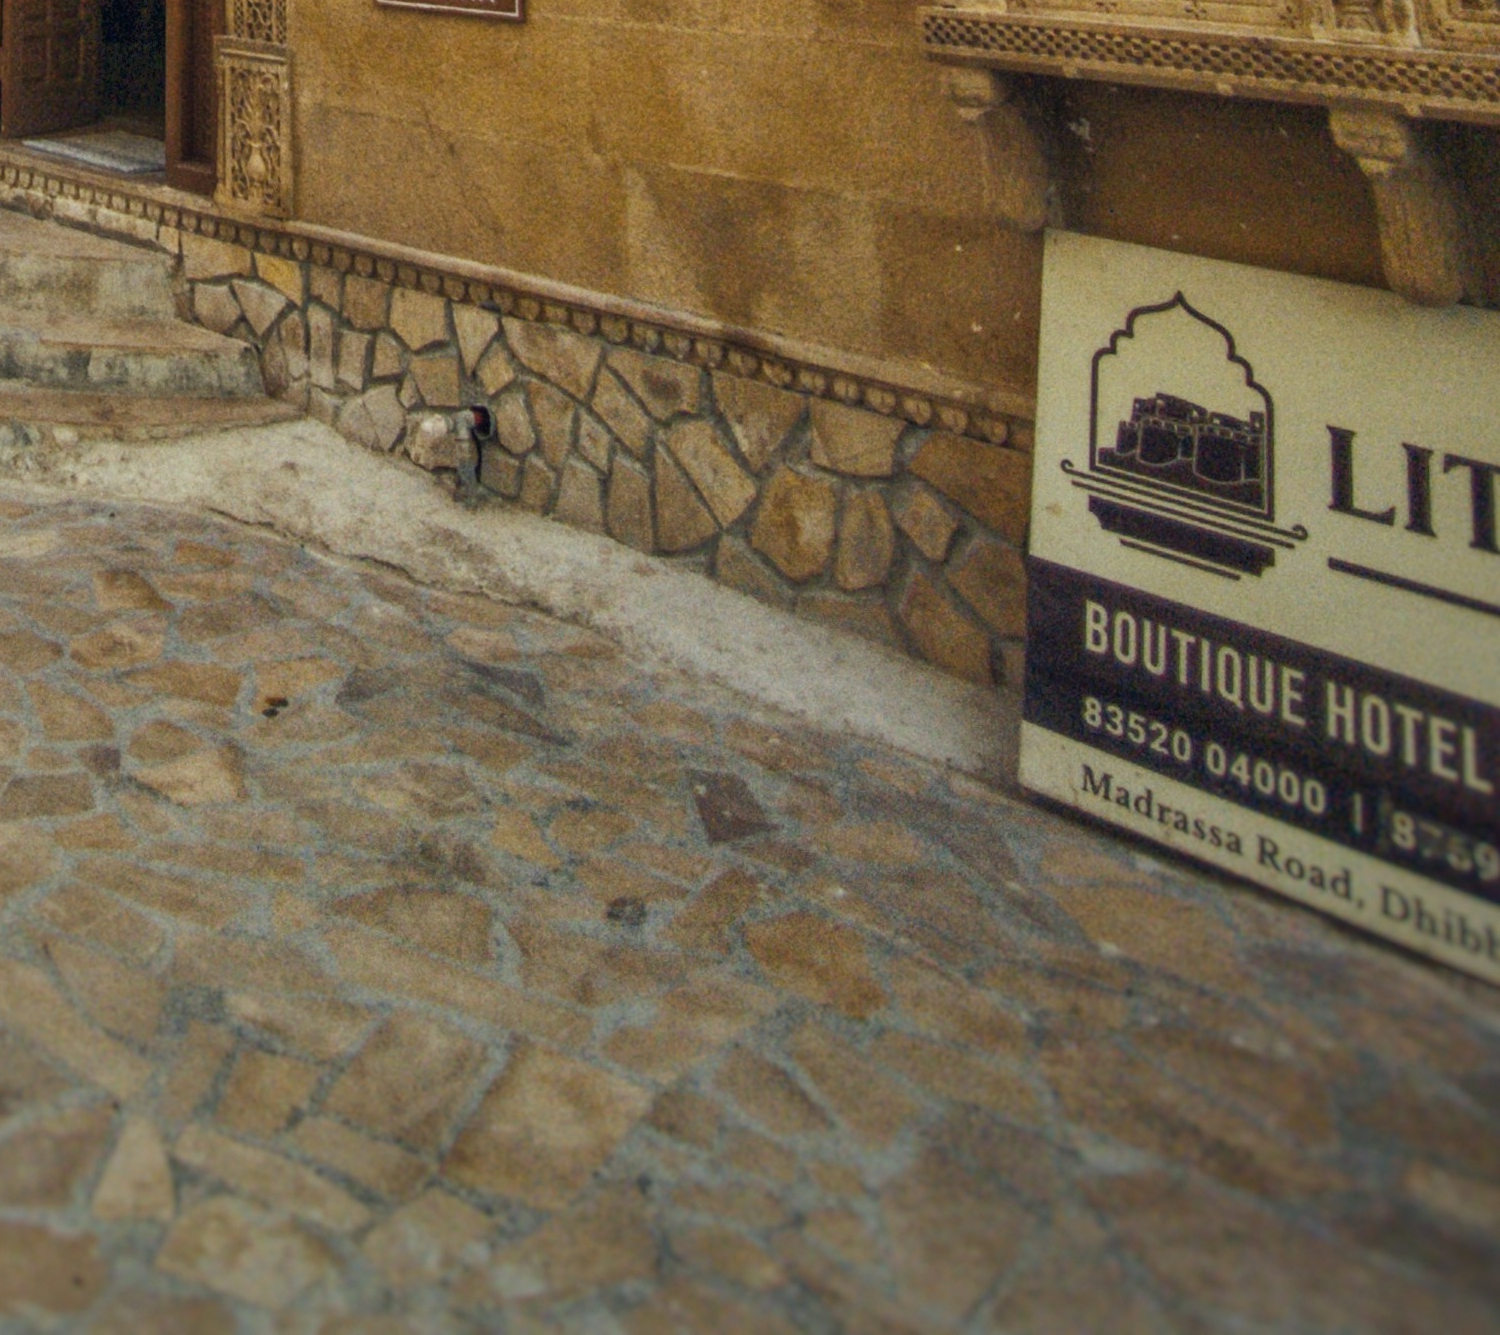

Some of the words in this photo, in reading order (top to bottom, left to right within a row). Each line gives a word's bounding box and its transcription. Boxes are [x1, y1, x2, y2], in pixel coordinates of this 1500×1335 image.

[1083, 695, 1192, 762] 83520
[1206, 742, 1327, 815] 04000
[1085, 599, 1306, 725] BOUTIQUE
[1326, 681, 1494, 794] HOTEL
[1080, 763, 1244, 857] Madrassa
[1257, 834, 1365, 911] Road,
